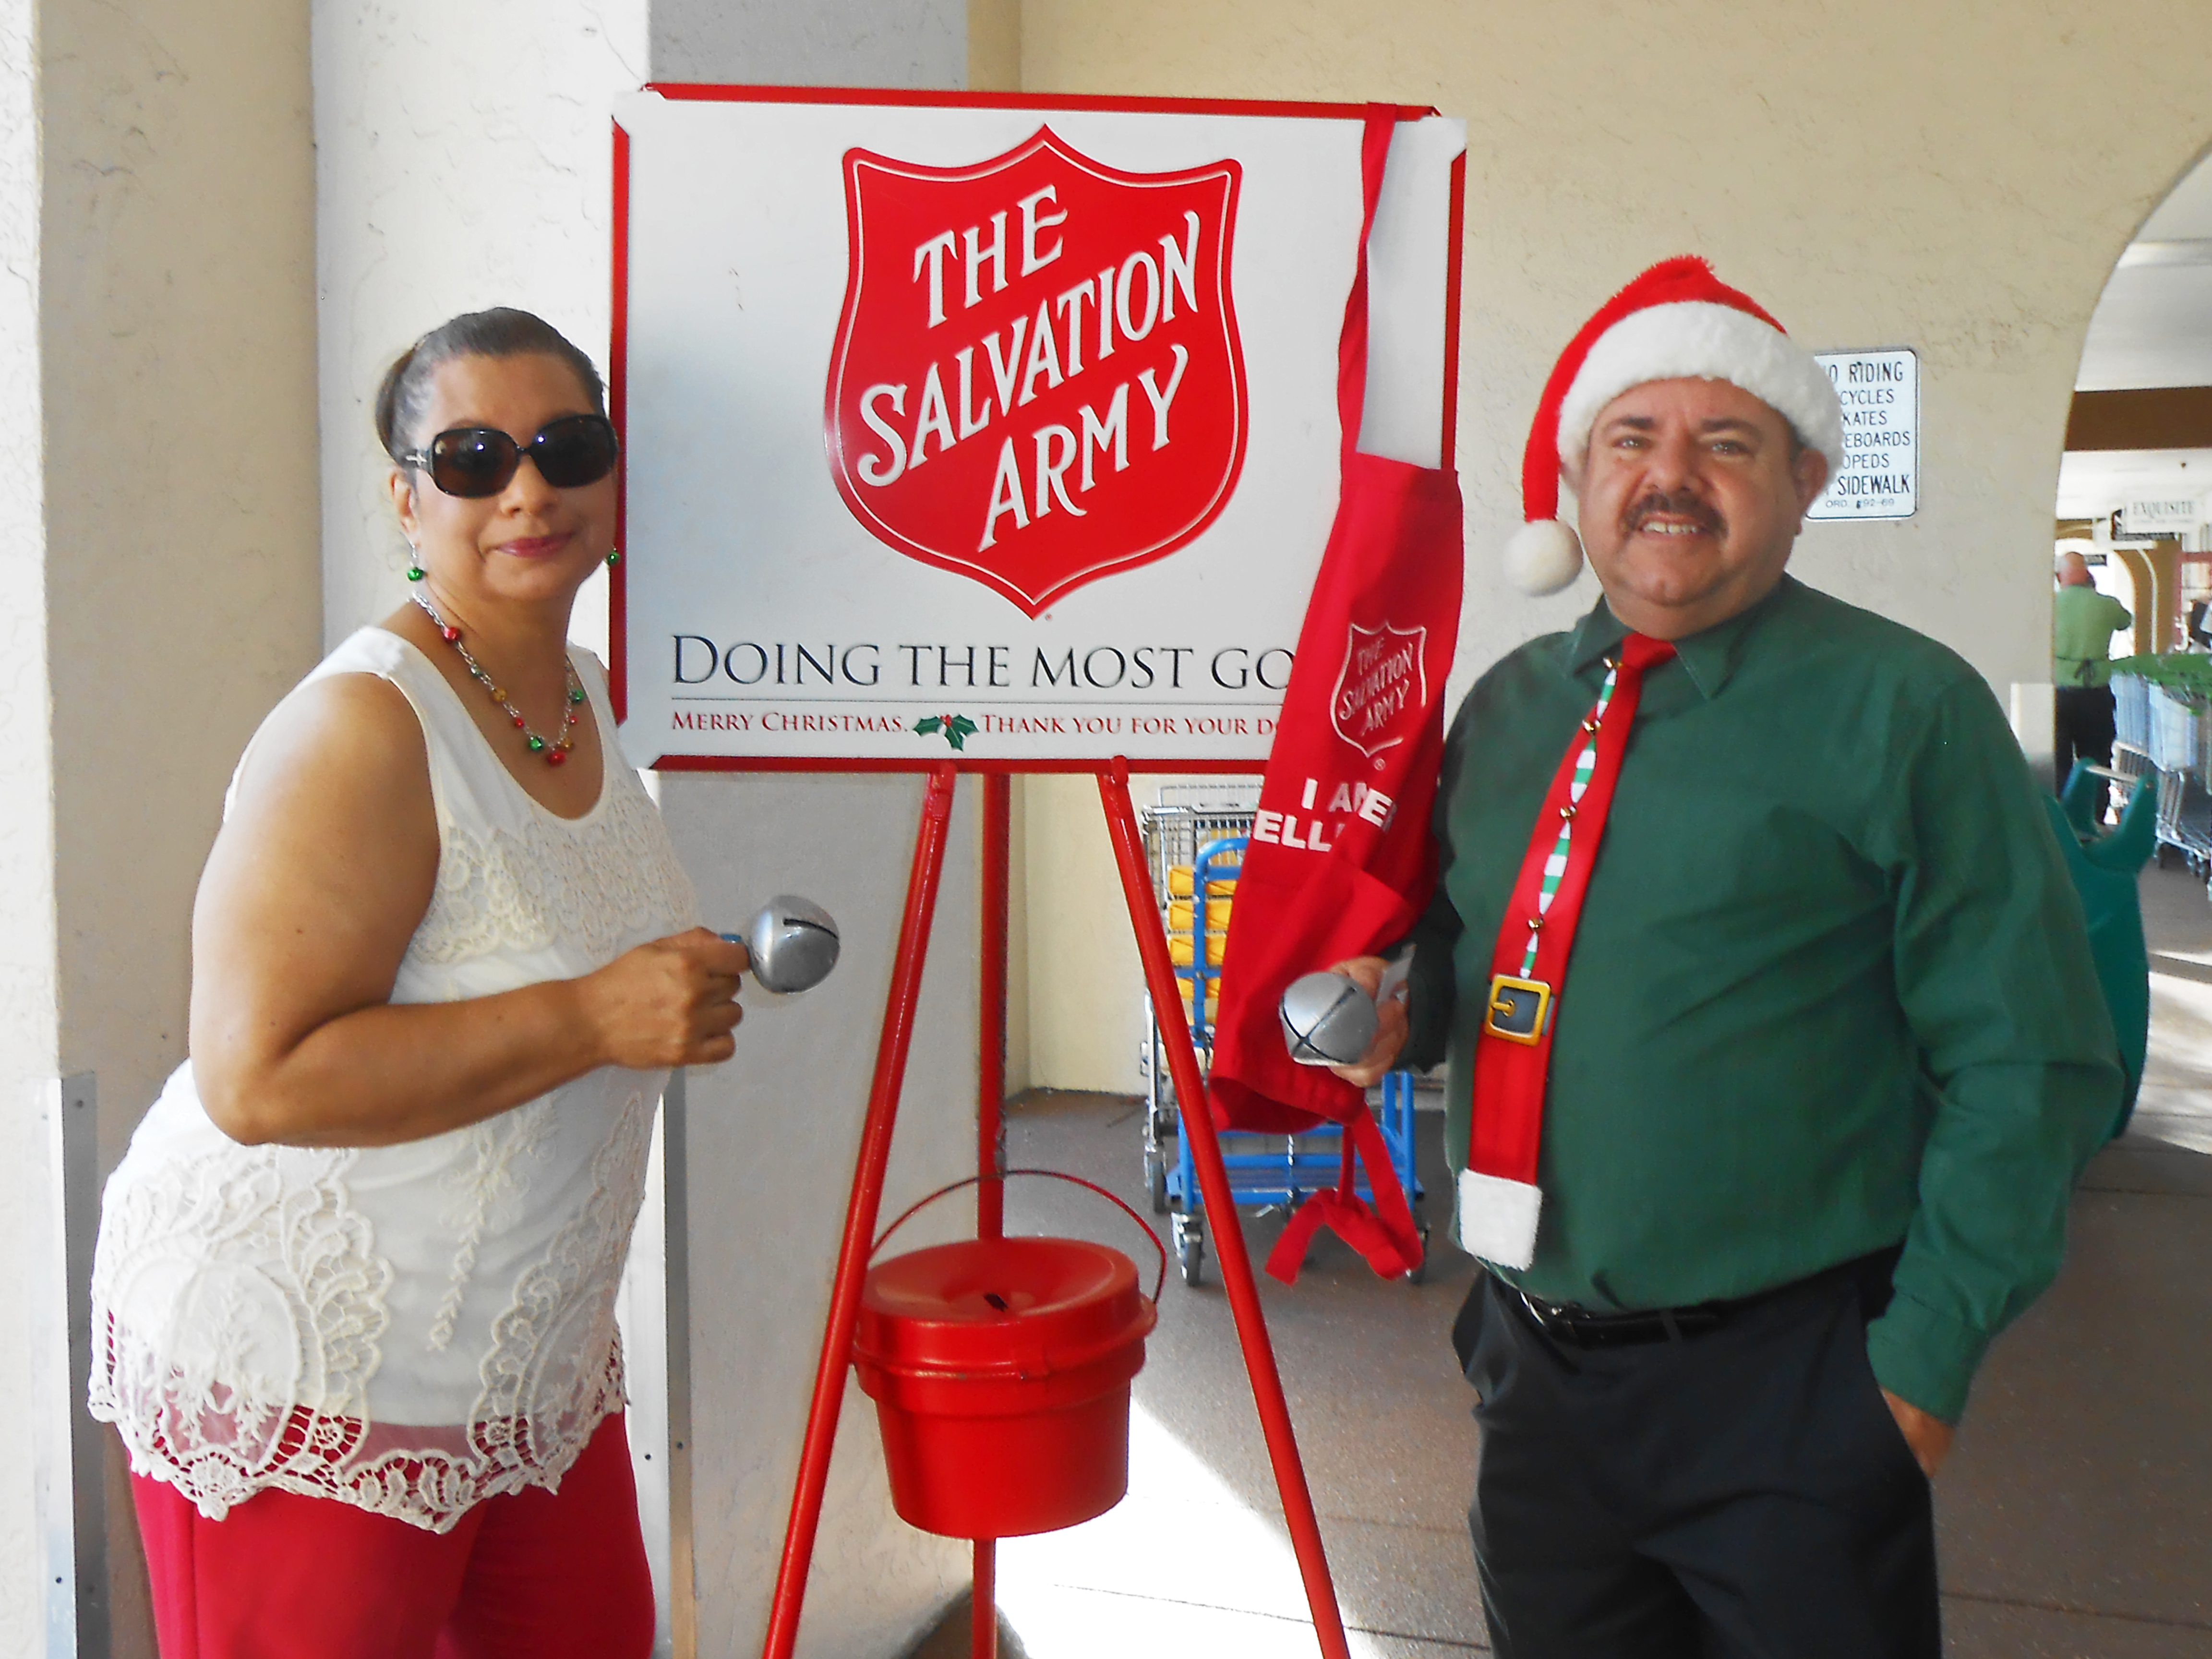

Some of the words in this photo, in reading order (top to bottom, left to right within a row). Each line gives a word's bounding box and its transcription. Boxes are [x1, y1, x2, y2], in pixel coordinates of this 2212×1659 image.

[913, 184, 1068, 328] THE
[857, 210, 1200, 487] SALVATION
[1825, 364, 1838, 383] O
[1849, 361, 1903, 383] RIDING
[977, 343, 1189, 553] ARMY
[1838, 474, 1910, 495] SIDEWALK
[673, 635, 881, 686] DOING
[1185, 718, 1249, 735] YOUR
[1360, 678, 1410, 737] ARMY
[1301, 777, 1318, 810] I
